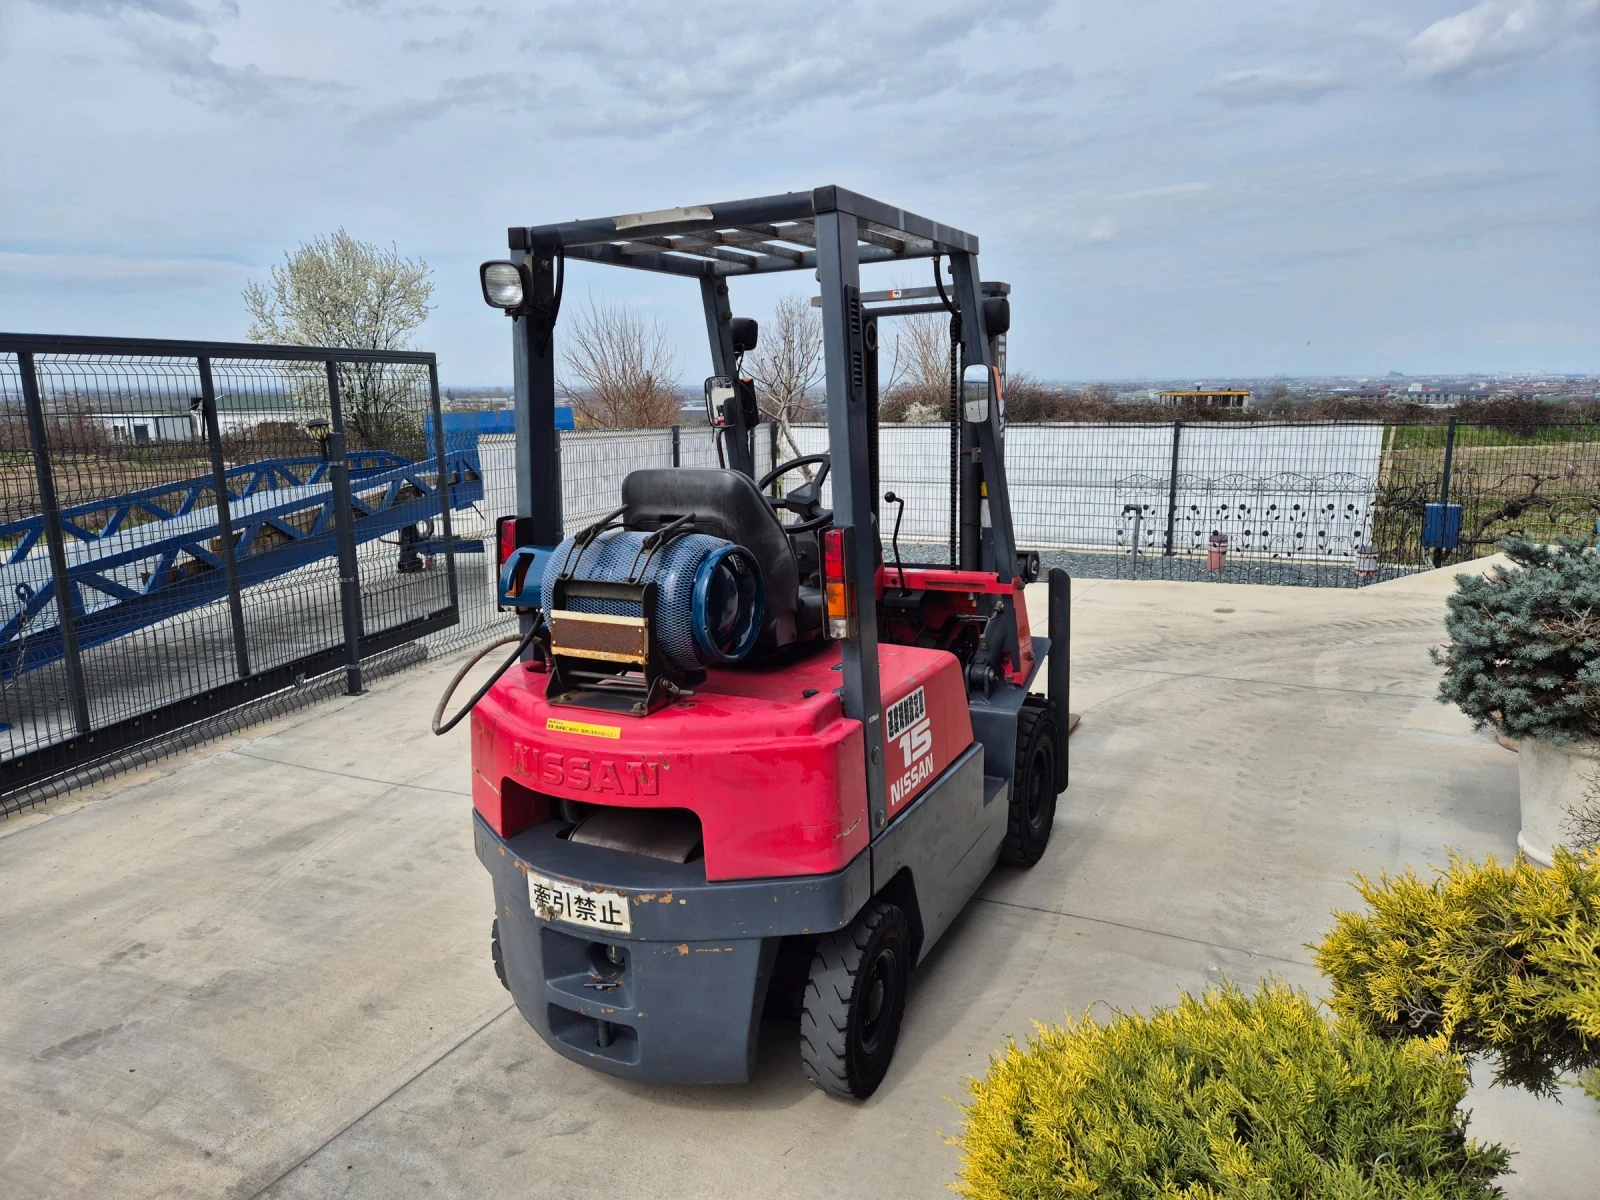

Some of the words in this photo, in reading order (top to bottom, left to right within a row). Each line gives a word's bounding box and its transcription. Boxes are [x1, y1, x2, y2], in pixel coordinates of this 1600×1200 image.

[513, 741, 660, 796] NISSAN
[899, 717, 932, 769] 15
[890, 752, 934, 807] NISSAN
